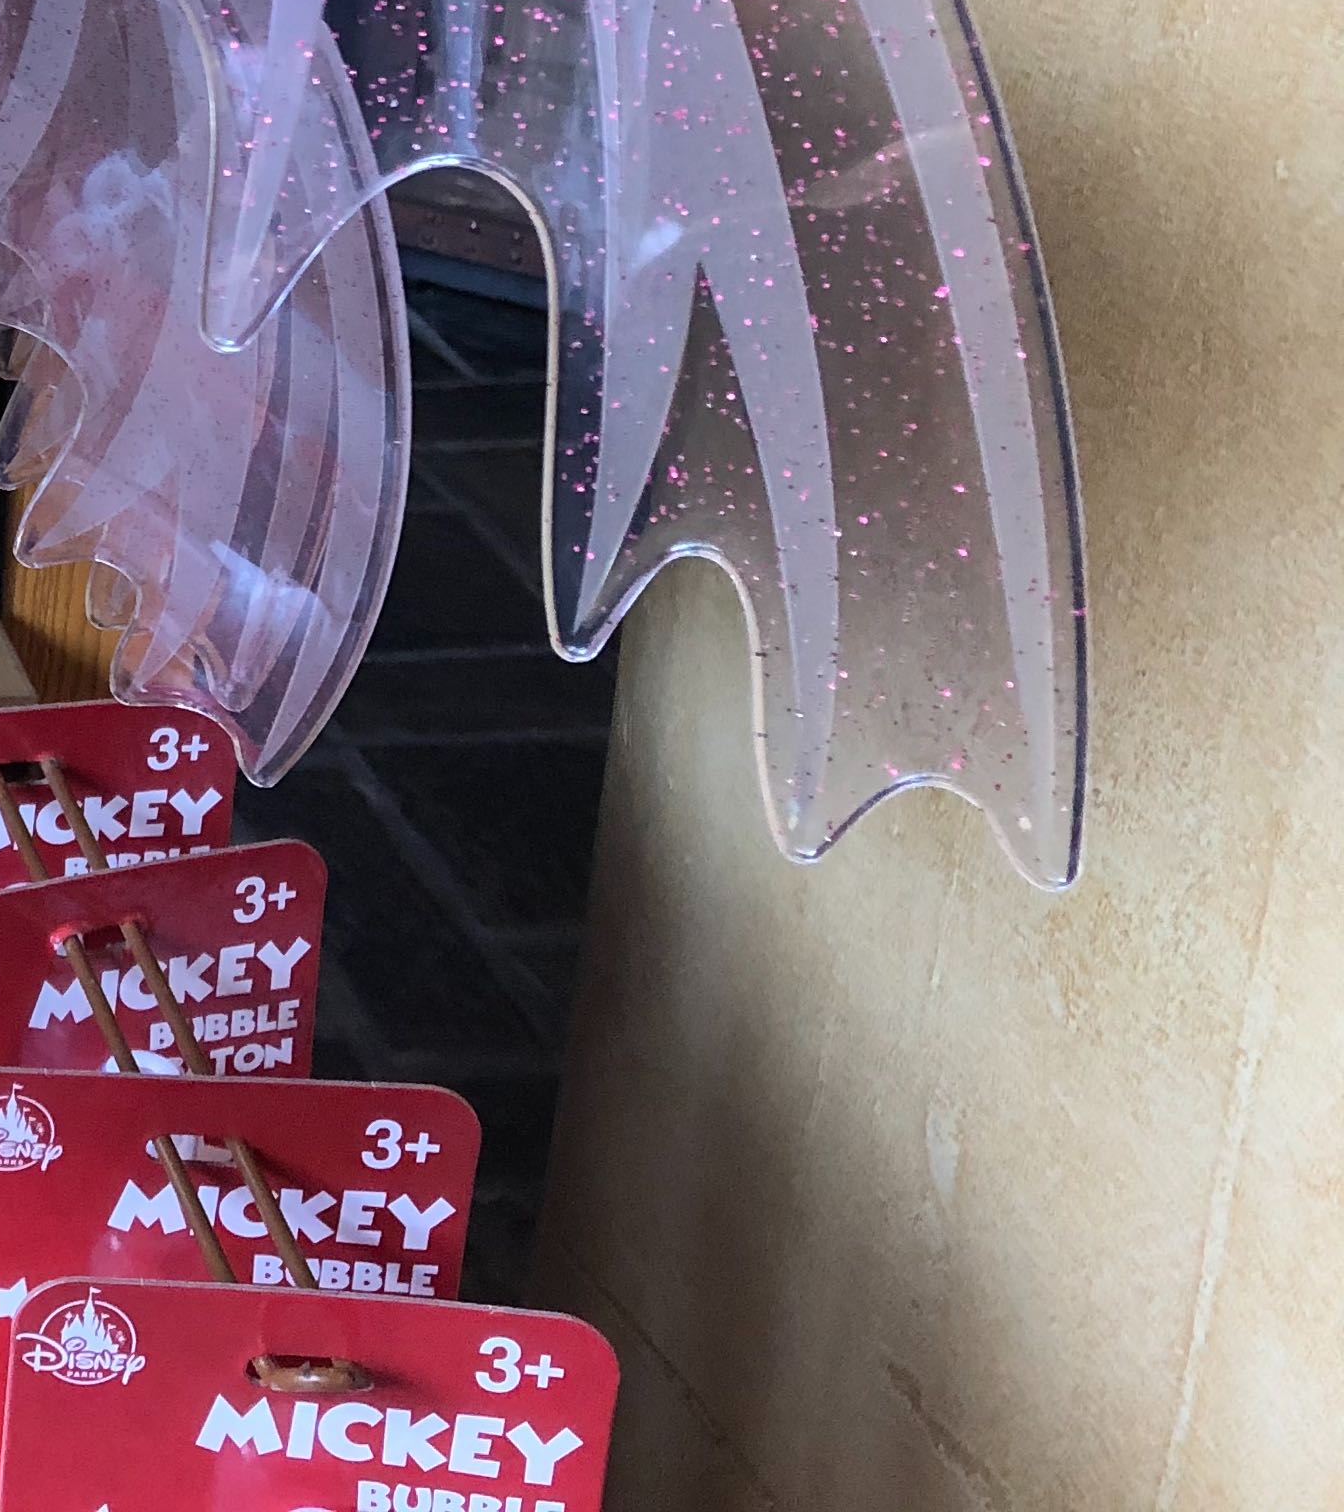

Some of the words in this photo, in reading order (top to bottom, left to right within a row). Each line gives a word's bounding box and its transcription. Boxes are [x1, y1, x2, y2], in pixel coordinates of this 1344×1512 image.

[147, 727, 210, 771] 3+
[233, 875, 297, 924] 3+
[28, 936, 312, 1030] MICKEY
[361, 1119, 441, 1170] 3+
[474, 1336, 565, 1393] 3+
[195, 1393, 584, 1486] MICKEY
